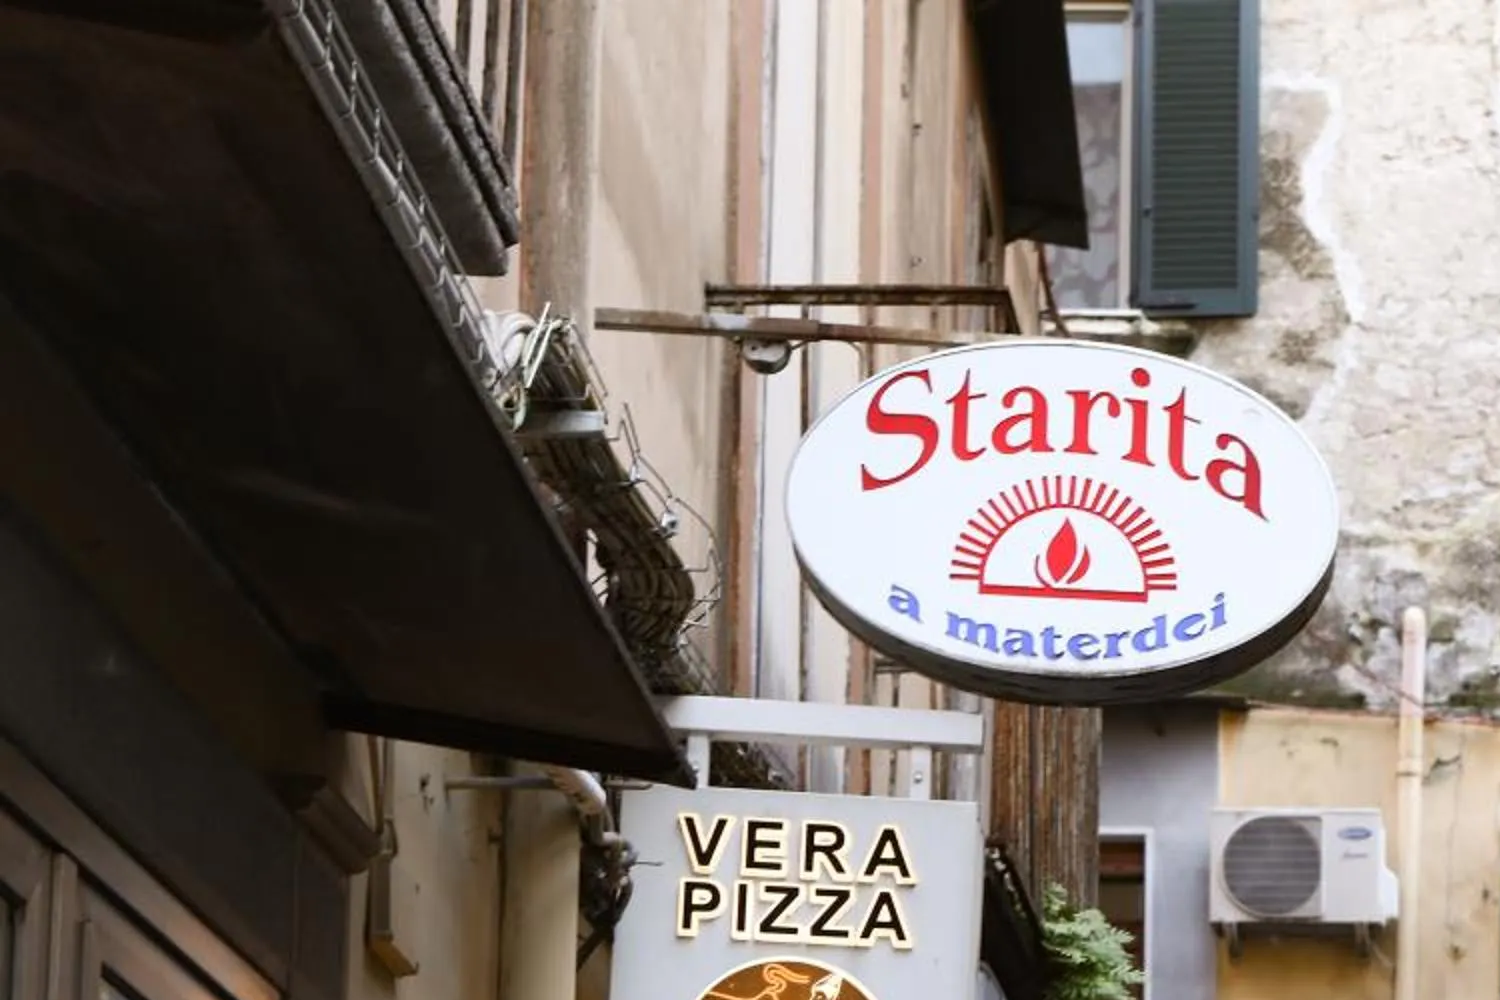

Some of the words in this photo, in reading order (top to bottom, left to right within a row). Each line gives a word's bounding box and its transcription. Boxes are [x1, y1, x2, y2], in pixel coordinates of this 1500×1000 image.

[860, 366, 1270, 523] Starita
[887, 583, 925, 625] a
[945, 591, 1229, 661] materdei
[682, 814, 914, 880] VERA
[681, 880, 908, 942] PIZZA
